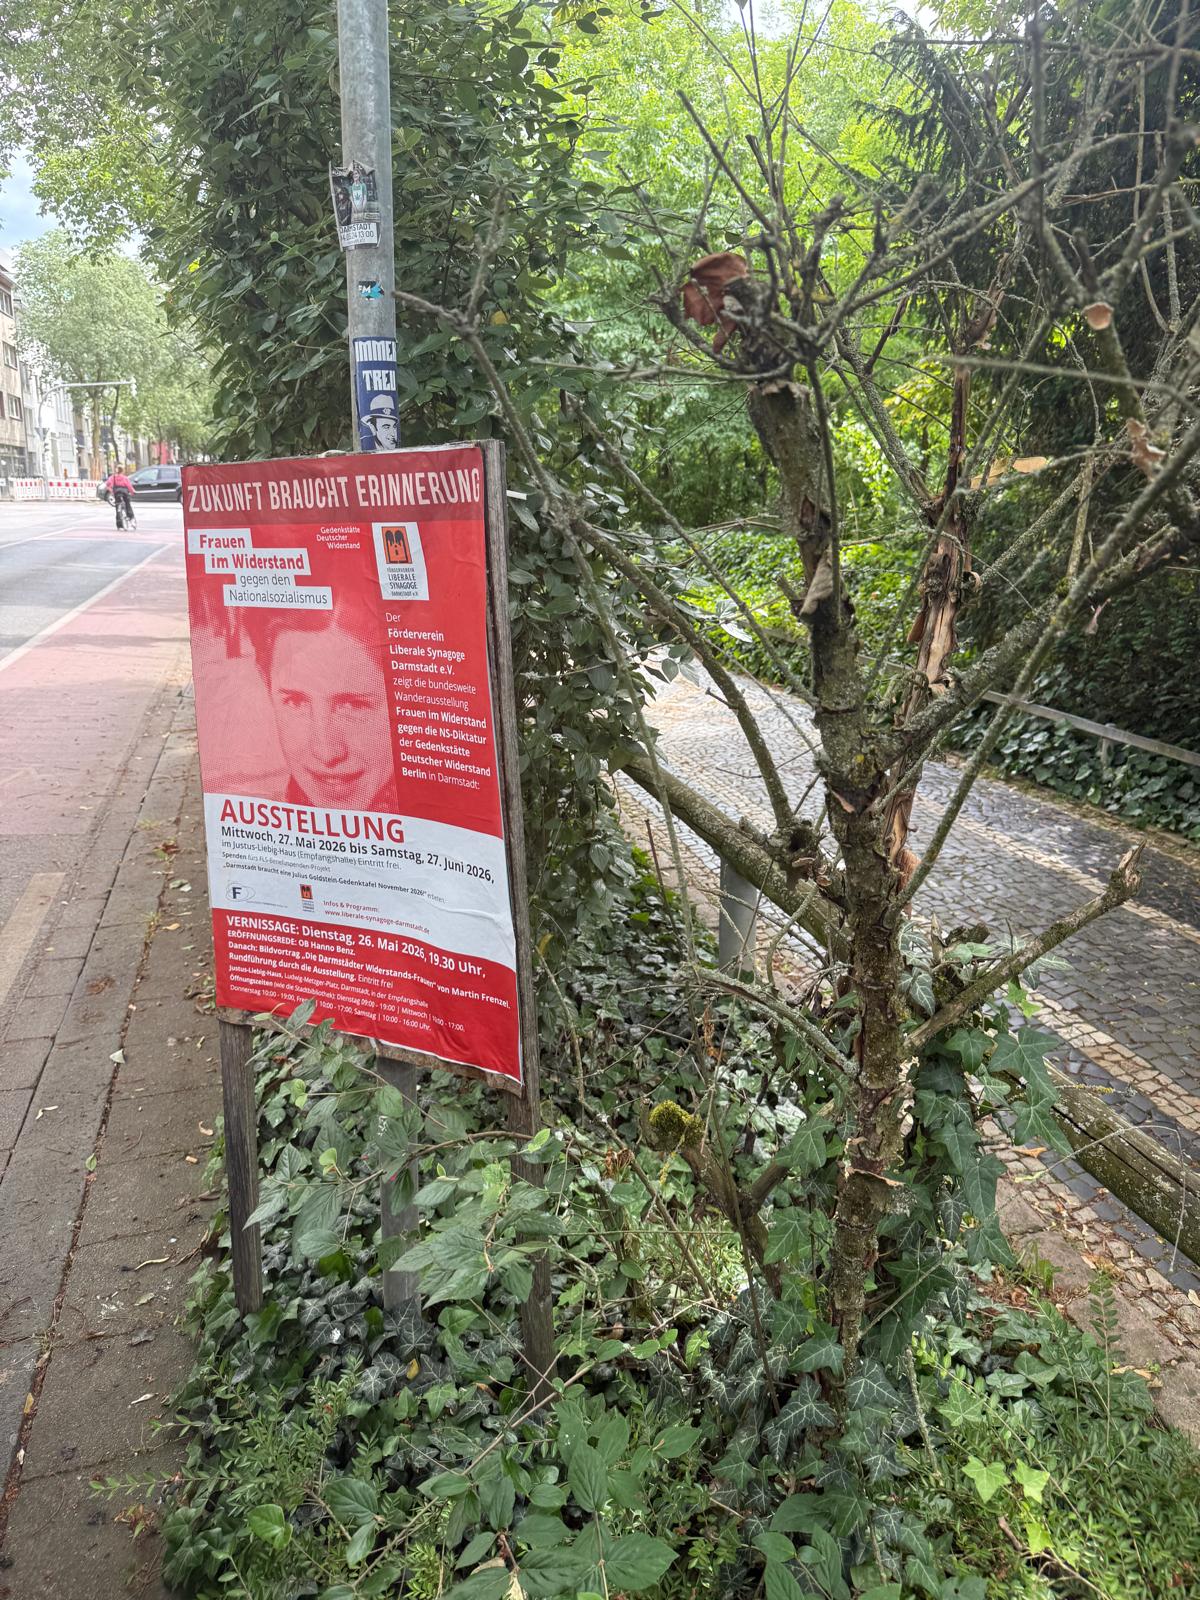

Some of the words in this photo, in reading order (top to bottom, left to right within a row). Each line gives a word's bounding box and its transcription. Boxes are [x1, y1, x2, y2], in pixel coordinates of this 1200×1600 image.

[362, 370, 397, 392] TREU
[188, 482, 262, 512] ZUKUNFT
[268, 476, 349, 510] BRAUCHT
[355, 468, 480, 507] ERINNERUNG
[316, 534, 348, 542] Deutscher
[320, 526, 361, 534] Gedenkstätte
[200, 534, 245, 548] Frauen
[211, 554, 229, 568] im
[232, 554, 304, 570] Widerstand
[240, 575, 272, 588] gegen
[272, 574, 290, 586] den
[388, 573, 416, 581] LIBERALE
[390, 582, 418, 590] SYNAGOGE
[229, 590, 328, 604] Nationalsozialismus
[386, 612, 400, 622] Der
[388, 628, 444, 642] Förderverein
[390, 644, 425, 656] Liberale
[427, 647, 465, 662] Synagoge
[392, 660, 437, 673] Darmstadt
[440, 665, 455, 676] e.V.
[393, 676, 412, 688] zeigt
[414, 677, 426, 688] die
[428, 679, 476, 694] bundesweite
[394, 691, 468, 712] Wanderausstellung
[396, 706, 426, 718] Frauen
[428, 710, 439, 720] im
[440, 711, 486, 728] Widerstand
[398, 724, 422, 735] gegen
[424, 726, 438, 736] die
[440, 728, 486, 744] NS-Diktatur
[400, 737, 413, 747] der
[415, 739, 470, 757] Gedenkstätte
[400, 752, 442, 767] Deutscher
[444, 759, 491, 776] Widerstand
[402, 767, 426, 780] Berlin
[428, 772, 436, 780] in
[438, 772, 480, 790] Darmstadt:
[220, 799, 404, 843] AUSSTELLUNG
[221, 826, 276, 844] Mittwoch,
[278, 833, 292, 846] 27.
[296, 836, 316, 849] Mai
[319, 840, 346, 852] 2026
[350, 842, 368, 854] bis
[371, 844, 424, 865] Samstag,
[427, 853, 442, 867] 27.
[444, 857, 464, 873] Juni
[466, 864, 494, 884] 2026,
[222, 840, 232, 848] im
[232, 840, 296, 858] Justus-Liebig-Haus
[358, 857, 385, 868] Eintritt
[222, 852, 247, 861] Spenden
[258, 865, 279, 874] braucht
[292, 872, 308, 880] Julius
[378, 882, 410, 893] November
[232, 886, 242, 899] F
[323, 900, 338, 908] Infos
[325, 910, 430, 934] www.liberale-synagoge-darmstadt.de
[226, 915, 300, 935] VERNISSAGE:
[302, 926, 356, 945] Dienstag,
[358, 934, 374, 948] 26.
[378, 938, 398, 952] Mai
[402, 942, 427, 962] 2026,
[428, 951, 455, 970] 19.30
[458, 960, 486, 978] Uhr,
[227, 930, 297, 946] ERÖFFNUNGSREDE:
[298, 939, 309, 948] OB
[310, 940, 334, 952] Hanno
[336, 945, 356, 956] Benz.
[228, 952, 278, 968] Rundführung
[278, 960, 300, 970] durch
[300, 963, 312, 972] die
[312, 966, 356, 982] Ausstellung.
[358, 974, 380, 986] Eintritt
[380, 978, 394, 988] frei
[228, 941, 258, 952] Danach:
[259, 945, 300, 959] Bildvortrag
[318, 953, 364, 970] Darmstädter
[436, 984, 450, 994] von
[452, 987, 480, 1000] Martin
[481, 994, 511, 1009] Frenzel.
[229, 964, 284, 978] Justus-Liebig-Haus,
[376, 991, 387, 999] der
[388, 994, 429, 1008] Empfangshalle
[230, 974, 274, 987] Öffnungszeiten
[286, 982, 294, 990] die
[336, 993, 361, 1006] Dienstag
[380, 1003, 396, 1012] 19:00
[402, 1007, 428, 1019] Mittwoch
[230, 984, 262, 996] Donnerstag
[262, 988, 276, 998] 10:00
[318, 1000, 334, 1009] 10:00
[354, 1009, 377, 1020] Samstag
[382, 1014, 398, 1024] 10:00
[402, 1018, 418, 1028] 16:00
